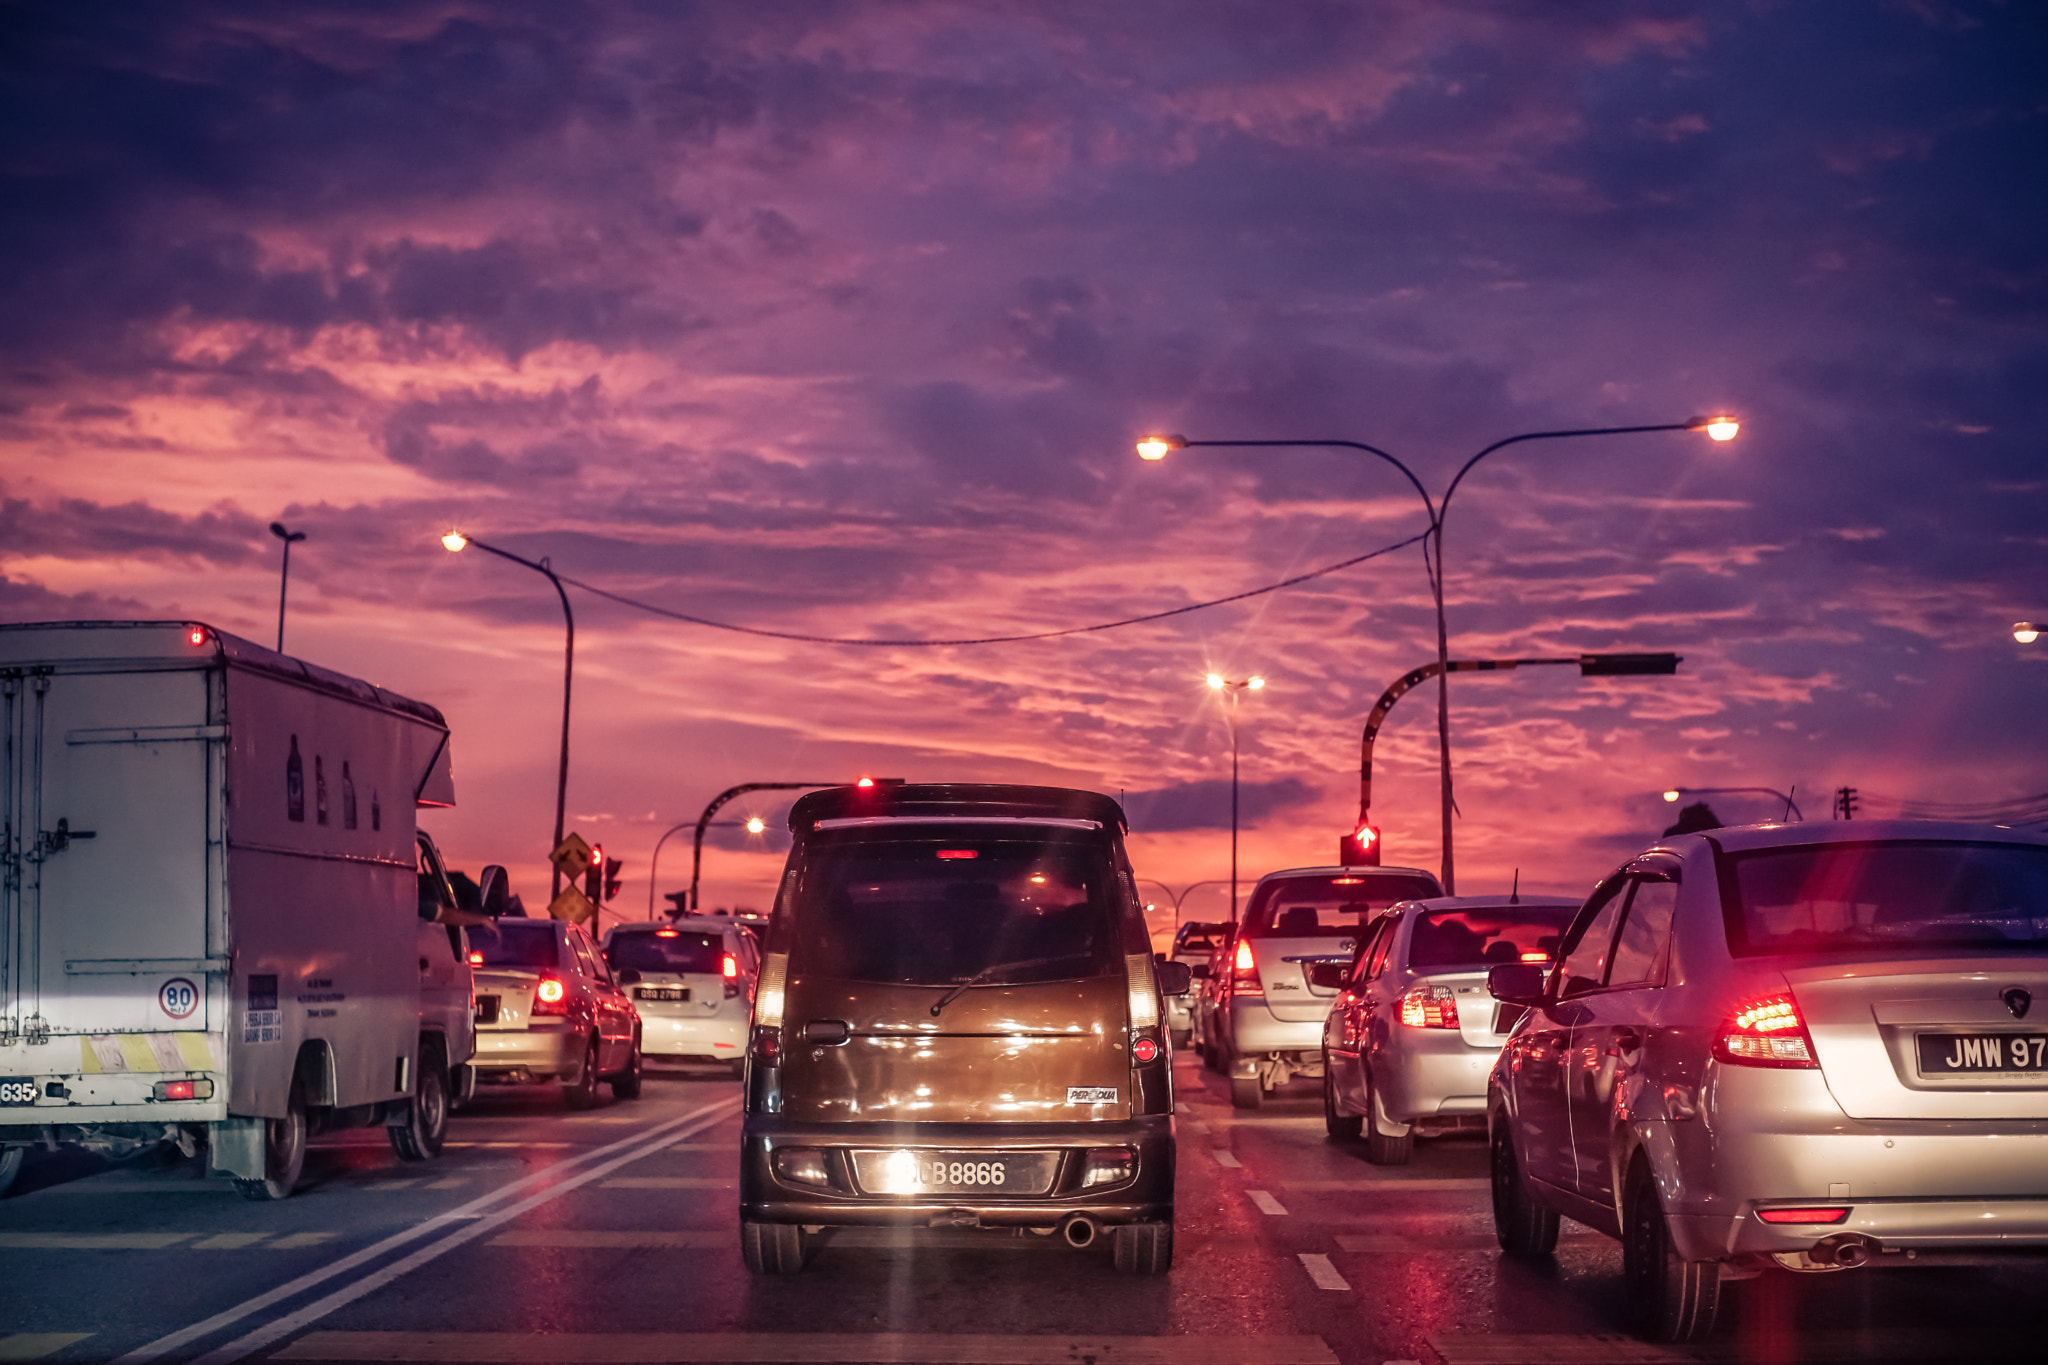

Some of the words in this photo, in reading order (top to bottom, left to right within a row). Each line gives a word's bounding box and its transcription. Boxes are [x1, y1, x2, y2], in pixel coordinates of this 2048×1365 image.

[166, 987, 191, 1006] 80
[1945, 1038, 2002, 1068] JMW
[2010, 1038, 2047, 1068] 97
[0, 1083, 33, 1102] 635
[949, 1162, 1006, 1185] 8866
